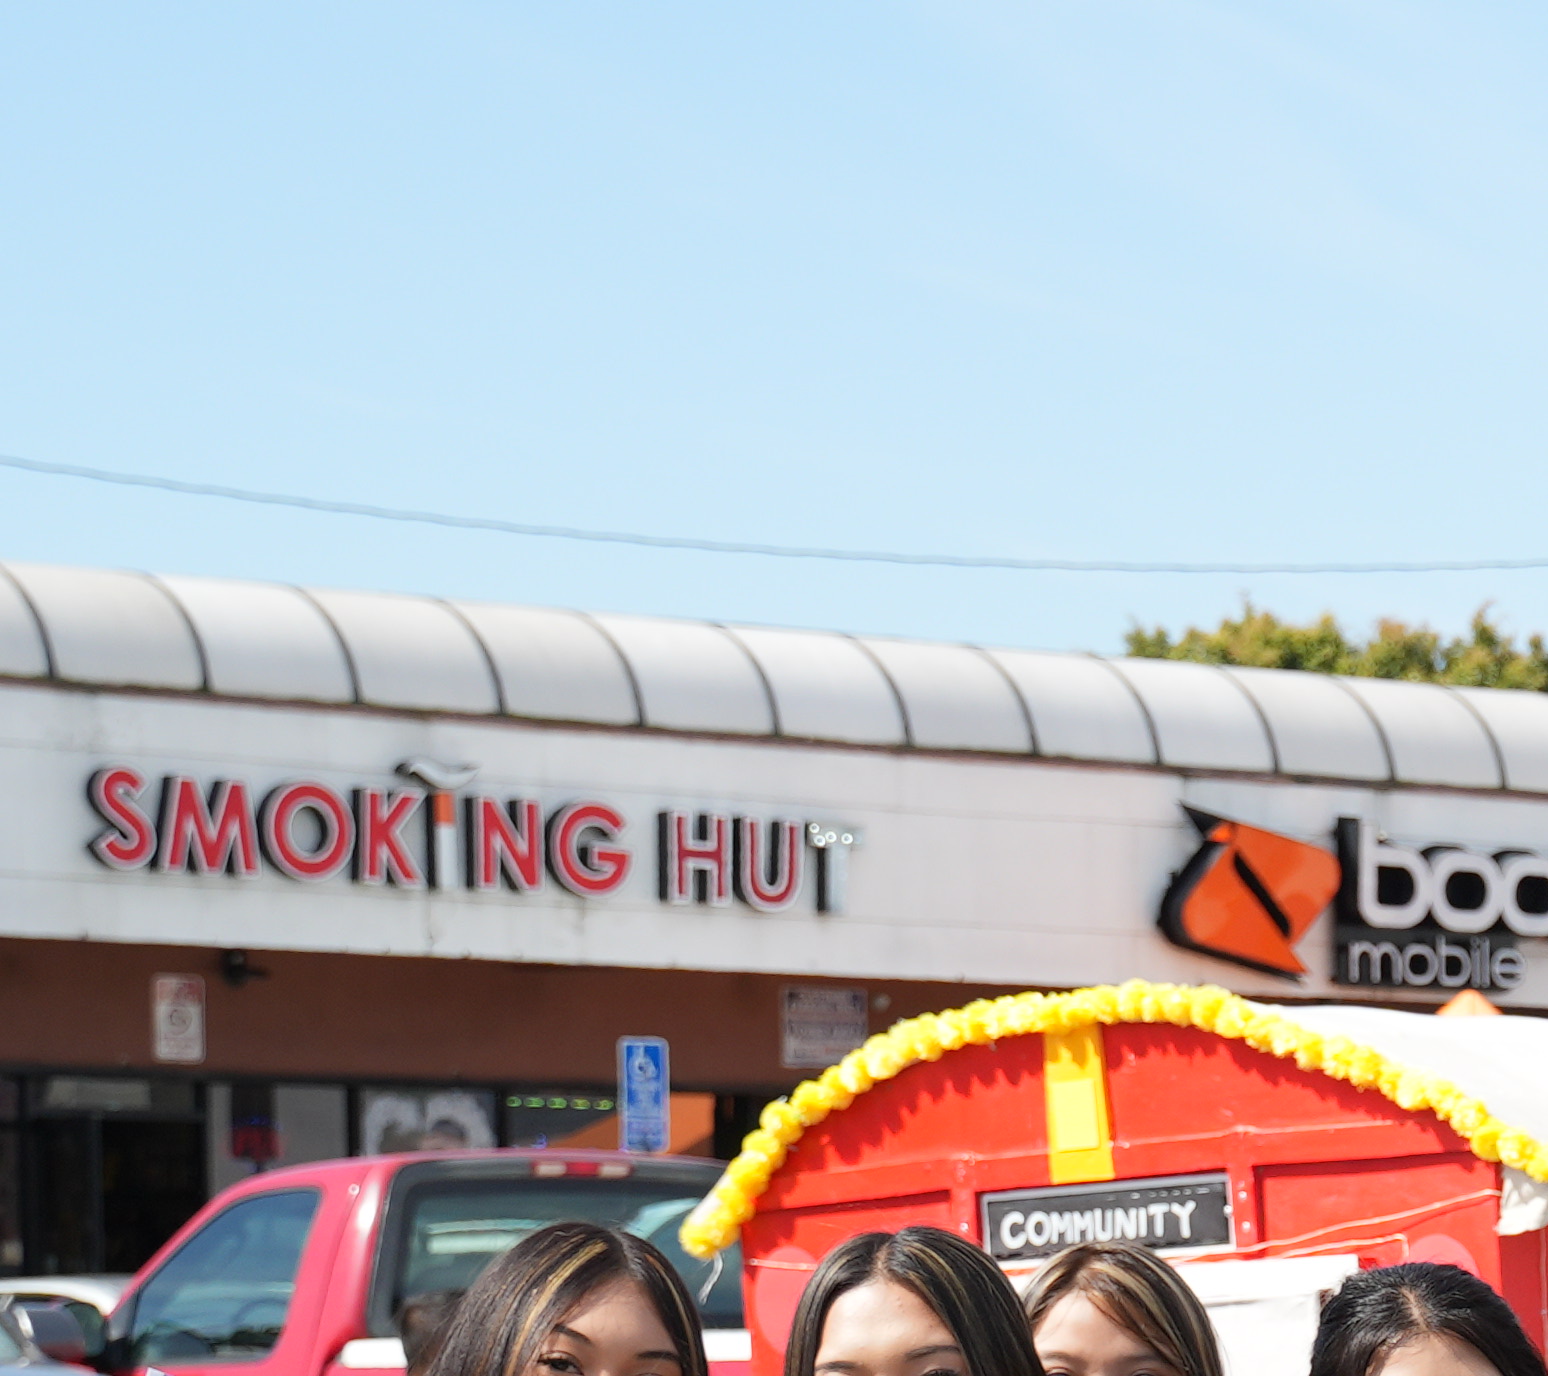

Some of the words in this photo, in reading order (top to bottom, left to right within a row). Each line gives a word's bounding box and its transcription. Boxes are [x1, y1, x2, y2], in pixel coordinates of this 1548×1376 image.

[90, 766, 633, 898] SMOKING
[660, 810, 860, 913] HUT
[1349, 934, 1526, 989] mobile
[1001, 1199, 1197, 1250] COMMUNITY
